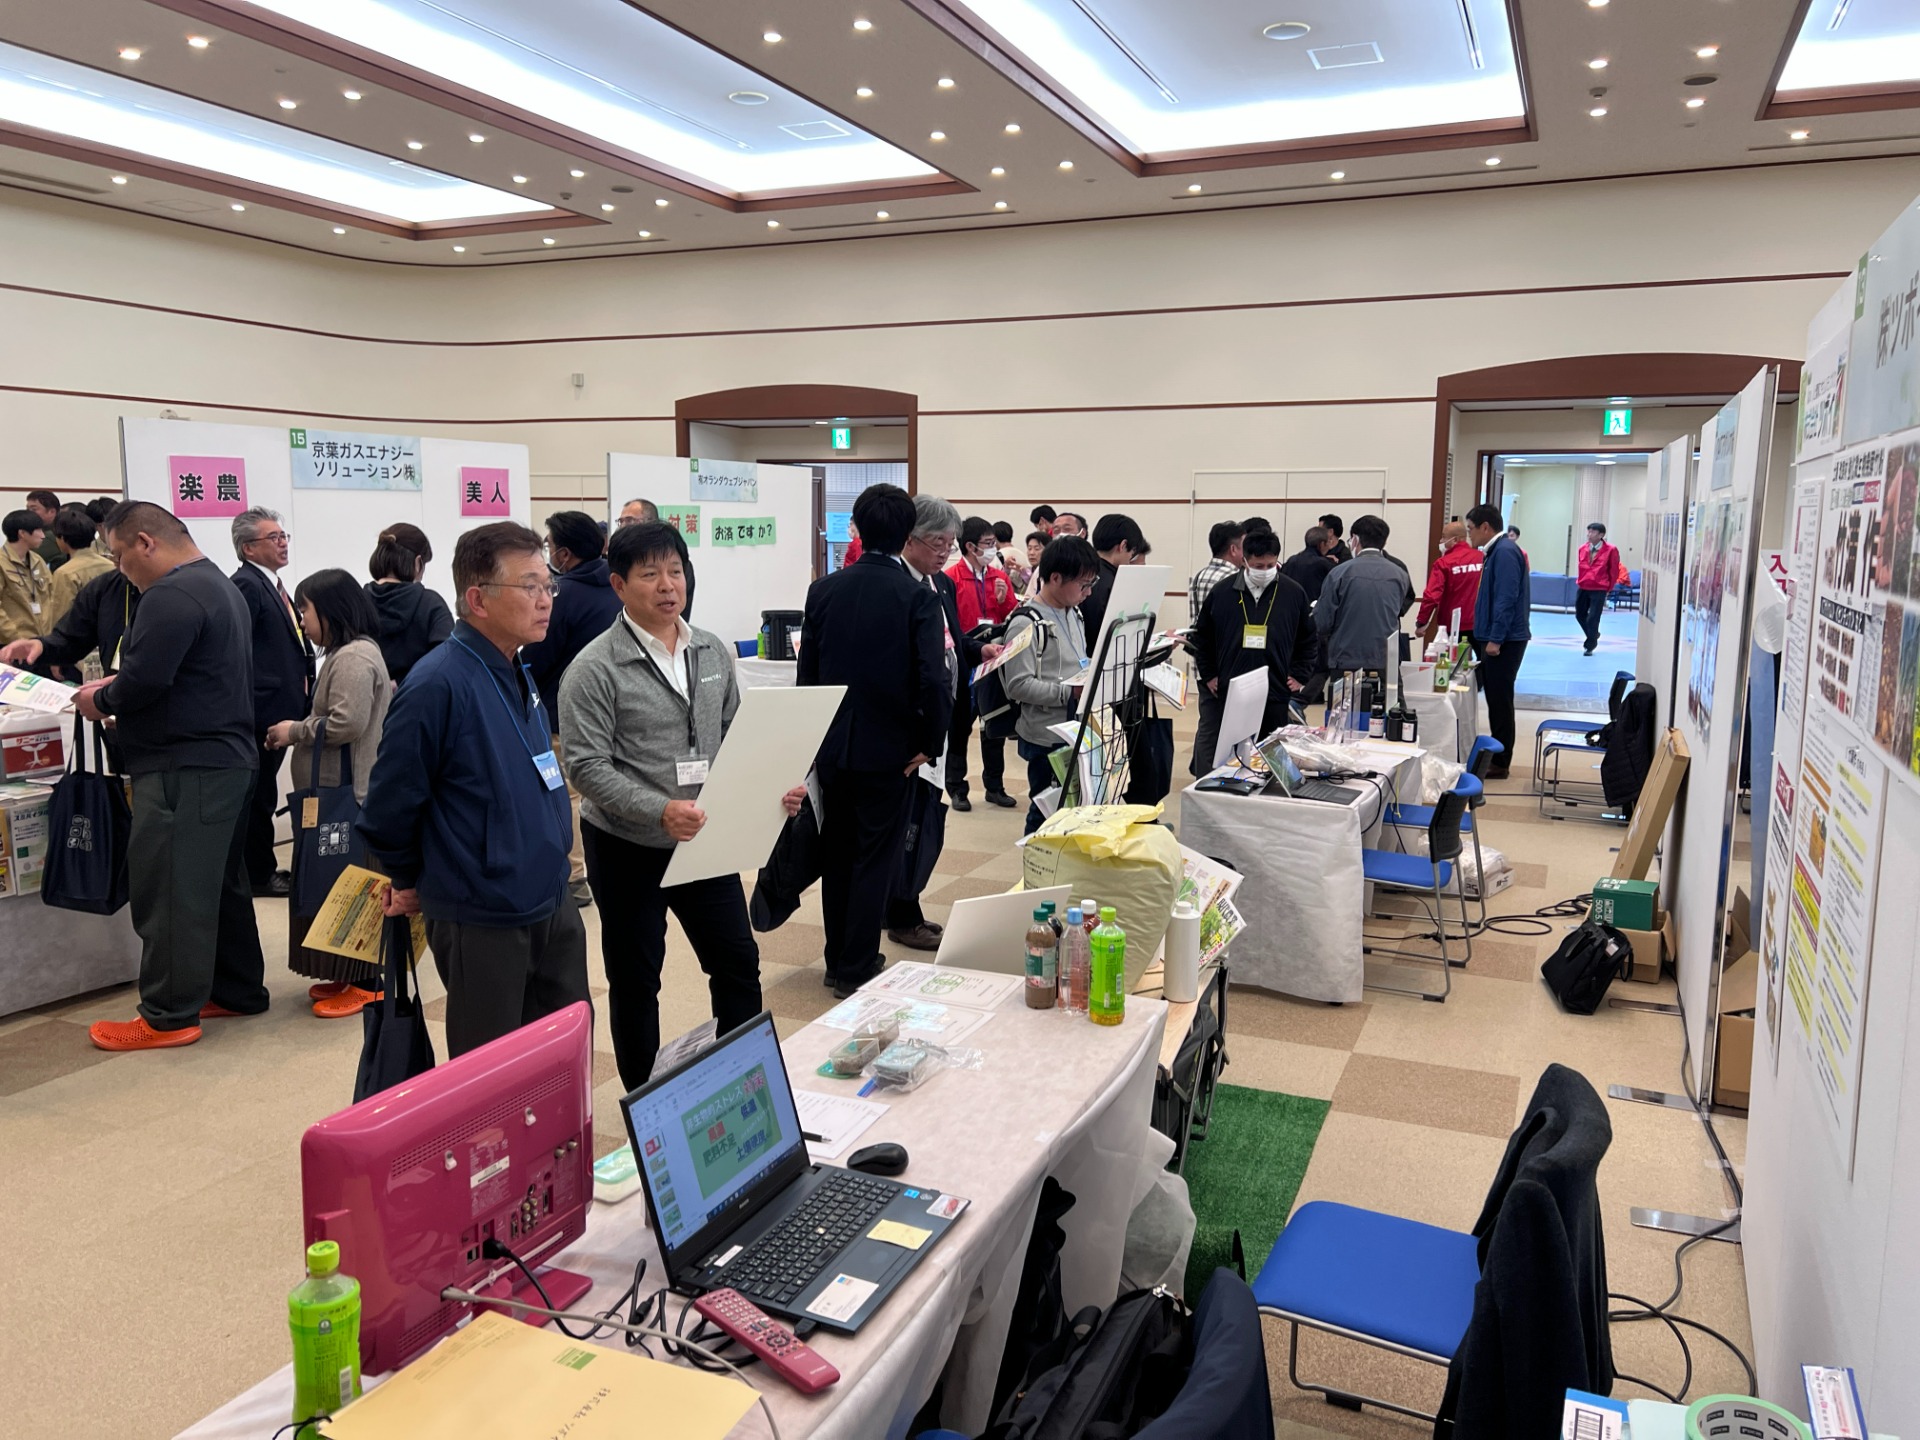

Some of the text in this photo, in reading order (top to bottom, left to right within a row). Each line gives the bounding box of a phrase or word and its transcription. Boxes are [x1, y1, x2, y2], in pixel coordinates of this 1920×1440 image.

[291, 432, 305, 445] 15
[312, 441, 413, 460] 京葉ガスエナジー
[466, 480, 506, 503] 美人
